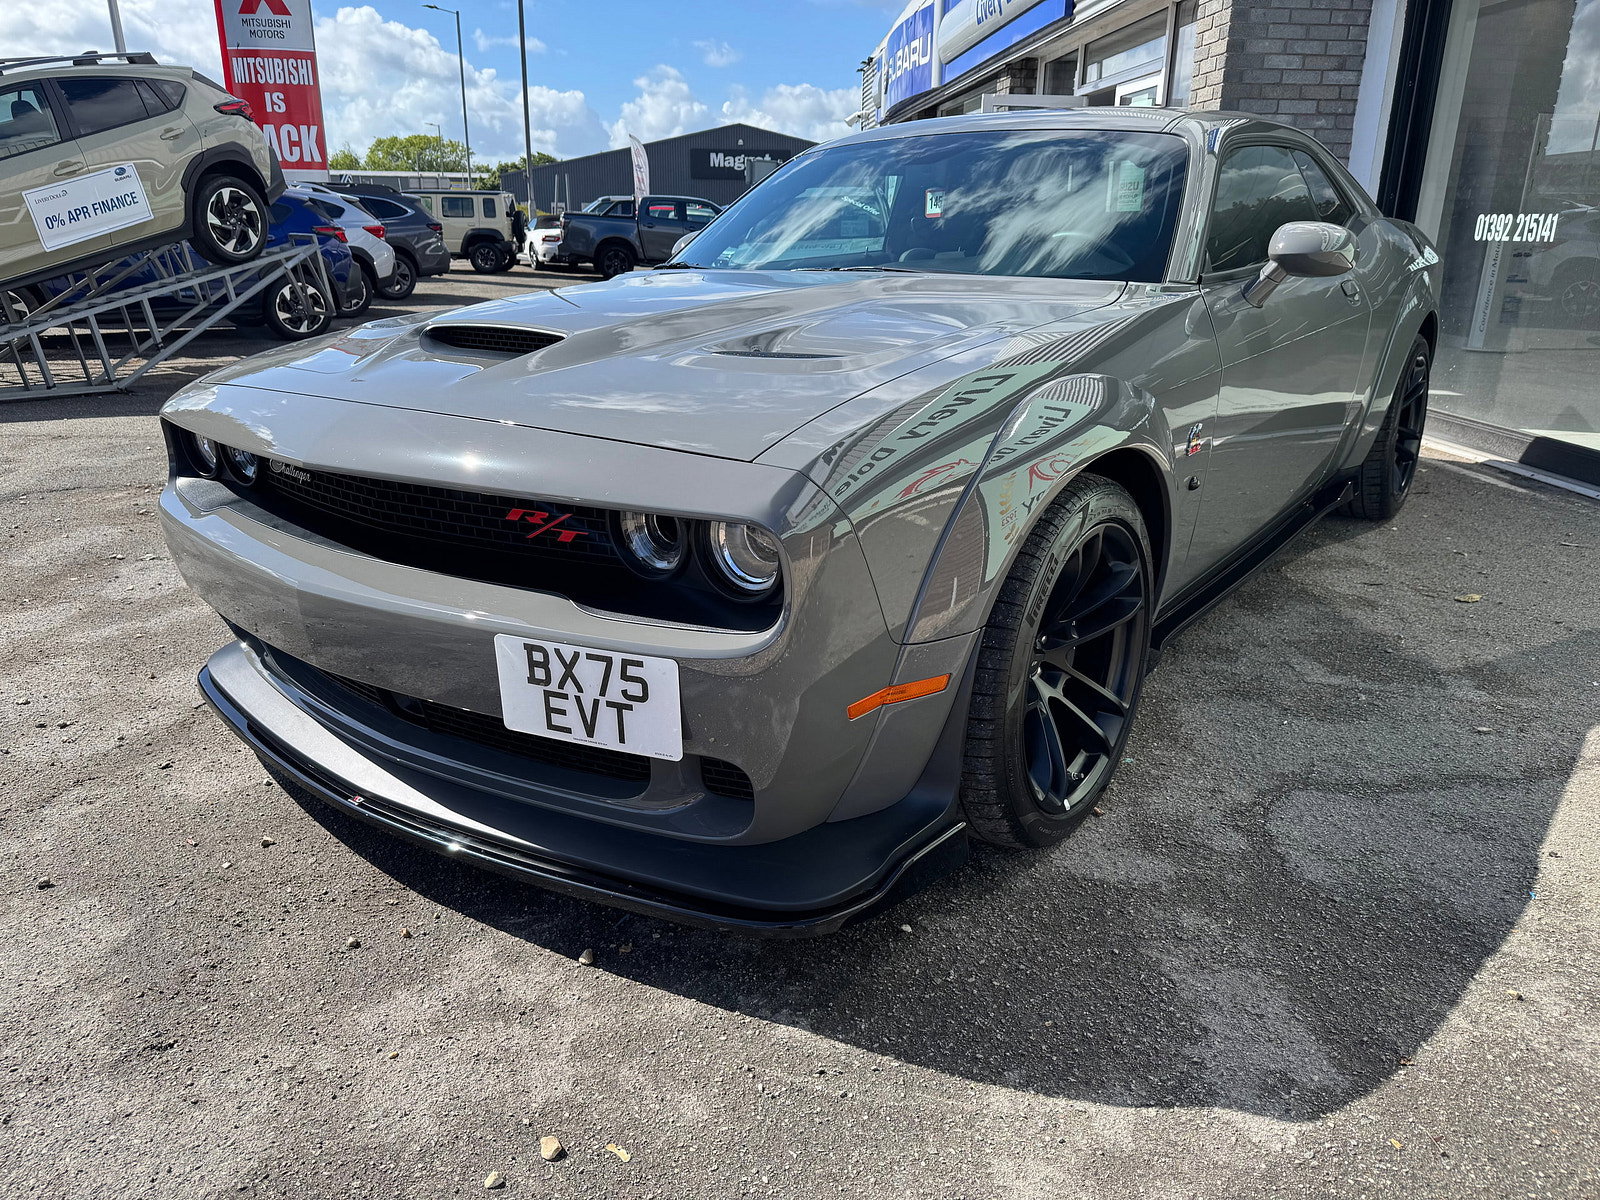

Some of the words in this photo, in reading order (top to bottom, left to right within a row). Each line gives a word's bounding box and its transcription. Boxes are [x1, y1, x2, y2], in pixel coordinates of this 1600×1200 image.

[241, 18, 291, 29] MITSUBISHI
[976, 0, 1002, 25] Livery
[249, 29, 285, 39] MOTORS
[232, 57, 314, 86] MITSUBISHI
[264, 91, 287, 113] IS
[263, 123, 322, 163] ACK
[709, 152, 772, 171] Mag
[114, 174, 132, 183] SUBARU
[45, 213, 66, 230] 0%
[67, 205, 92, 224] APR
[91, 191, 139, 217] FINANCE
[1474, 213, 1514, 242] 01392
[1512, 213, 1559, 243] 215141
[1479, 279, 1495, 333] Confidence
[269, 458, 312, 484] Challenger
[505, 508, 589, 543] R/T
[523, 642, 649, 703] BX75
[542, 689, 634, 744] EVT
